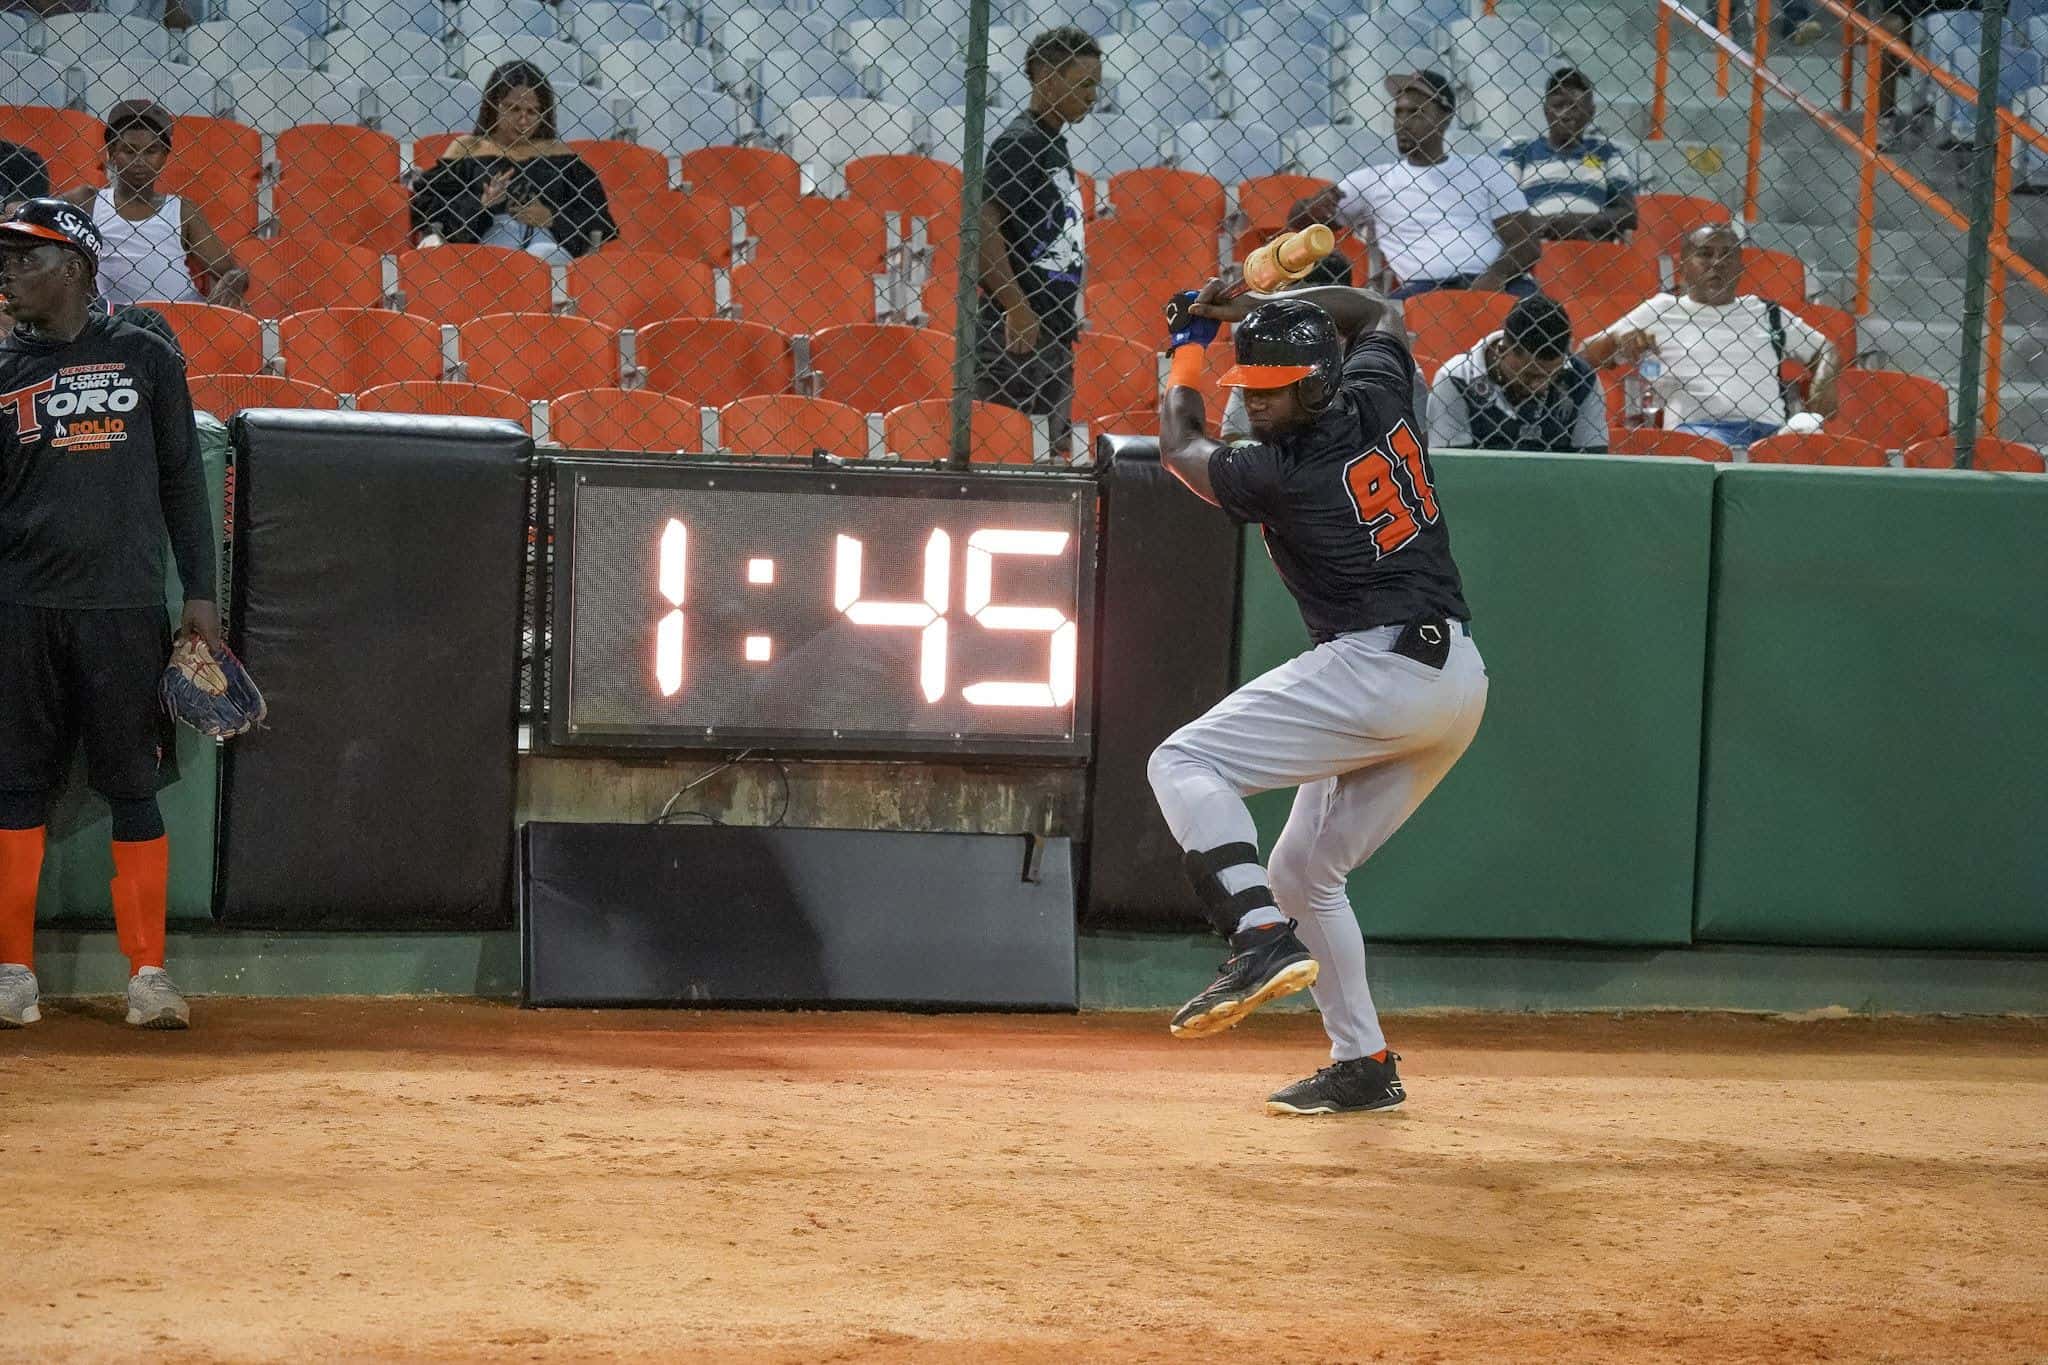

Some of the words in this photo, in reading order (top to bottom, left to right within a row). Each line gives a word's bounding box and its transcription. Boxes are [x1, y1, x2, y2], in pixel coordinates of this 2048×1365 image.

[60, 212, 101, 261] Siren
[0, 373, 138, 435] TORO
[69, 379, 110, 391] COMO
[113, 378, 133, 387] UN
[1342, 417, 1440, 561] 91
[656, 517, 1077, 707] 1:45
